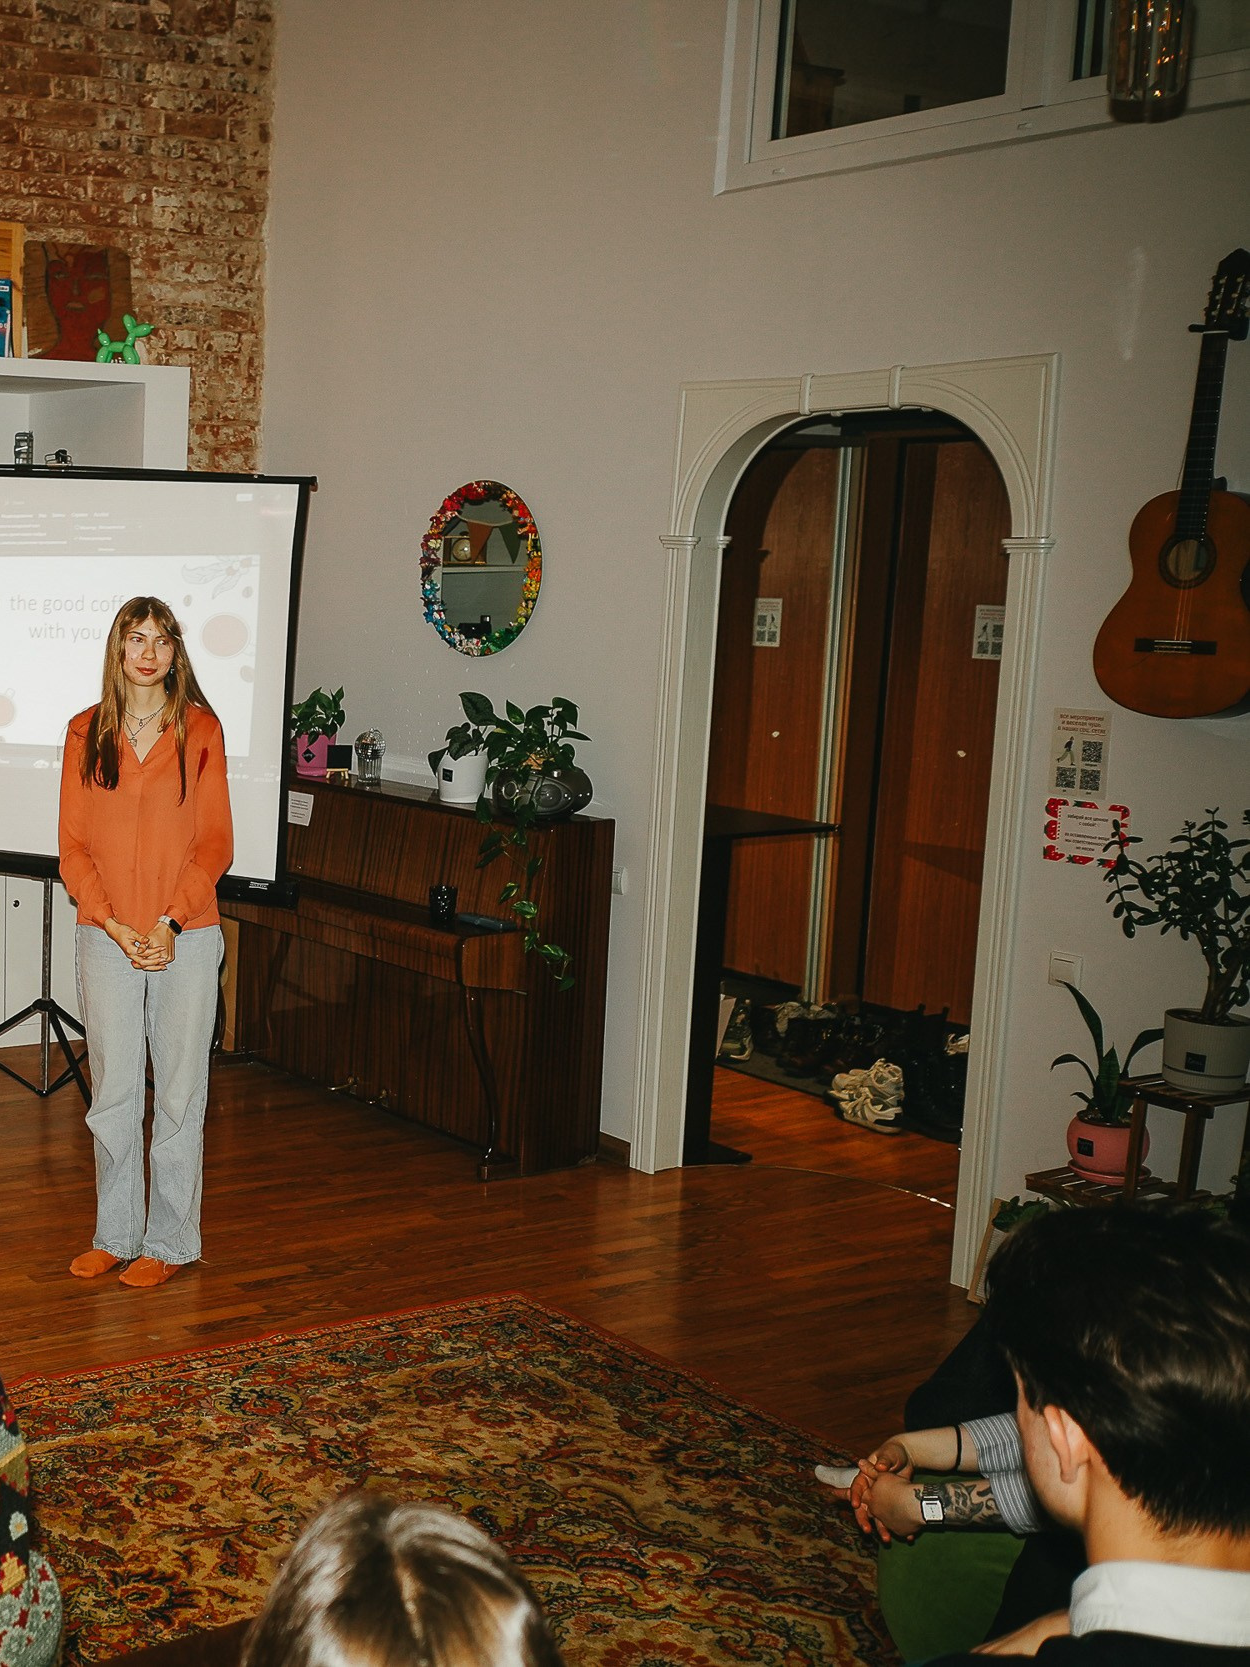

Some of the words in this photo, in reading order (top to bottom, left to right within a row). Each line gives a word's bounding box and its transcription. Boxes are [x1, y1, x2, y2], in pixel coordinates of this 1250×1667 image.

[10, 594, 37, 611] the
[43, 594, 85, 614] good
[91, 594, 125, 612] coff
[28, 622, 65, 639] with
[71, 627, 102, 643] you
